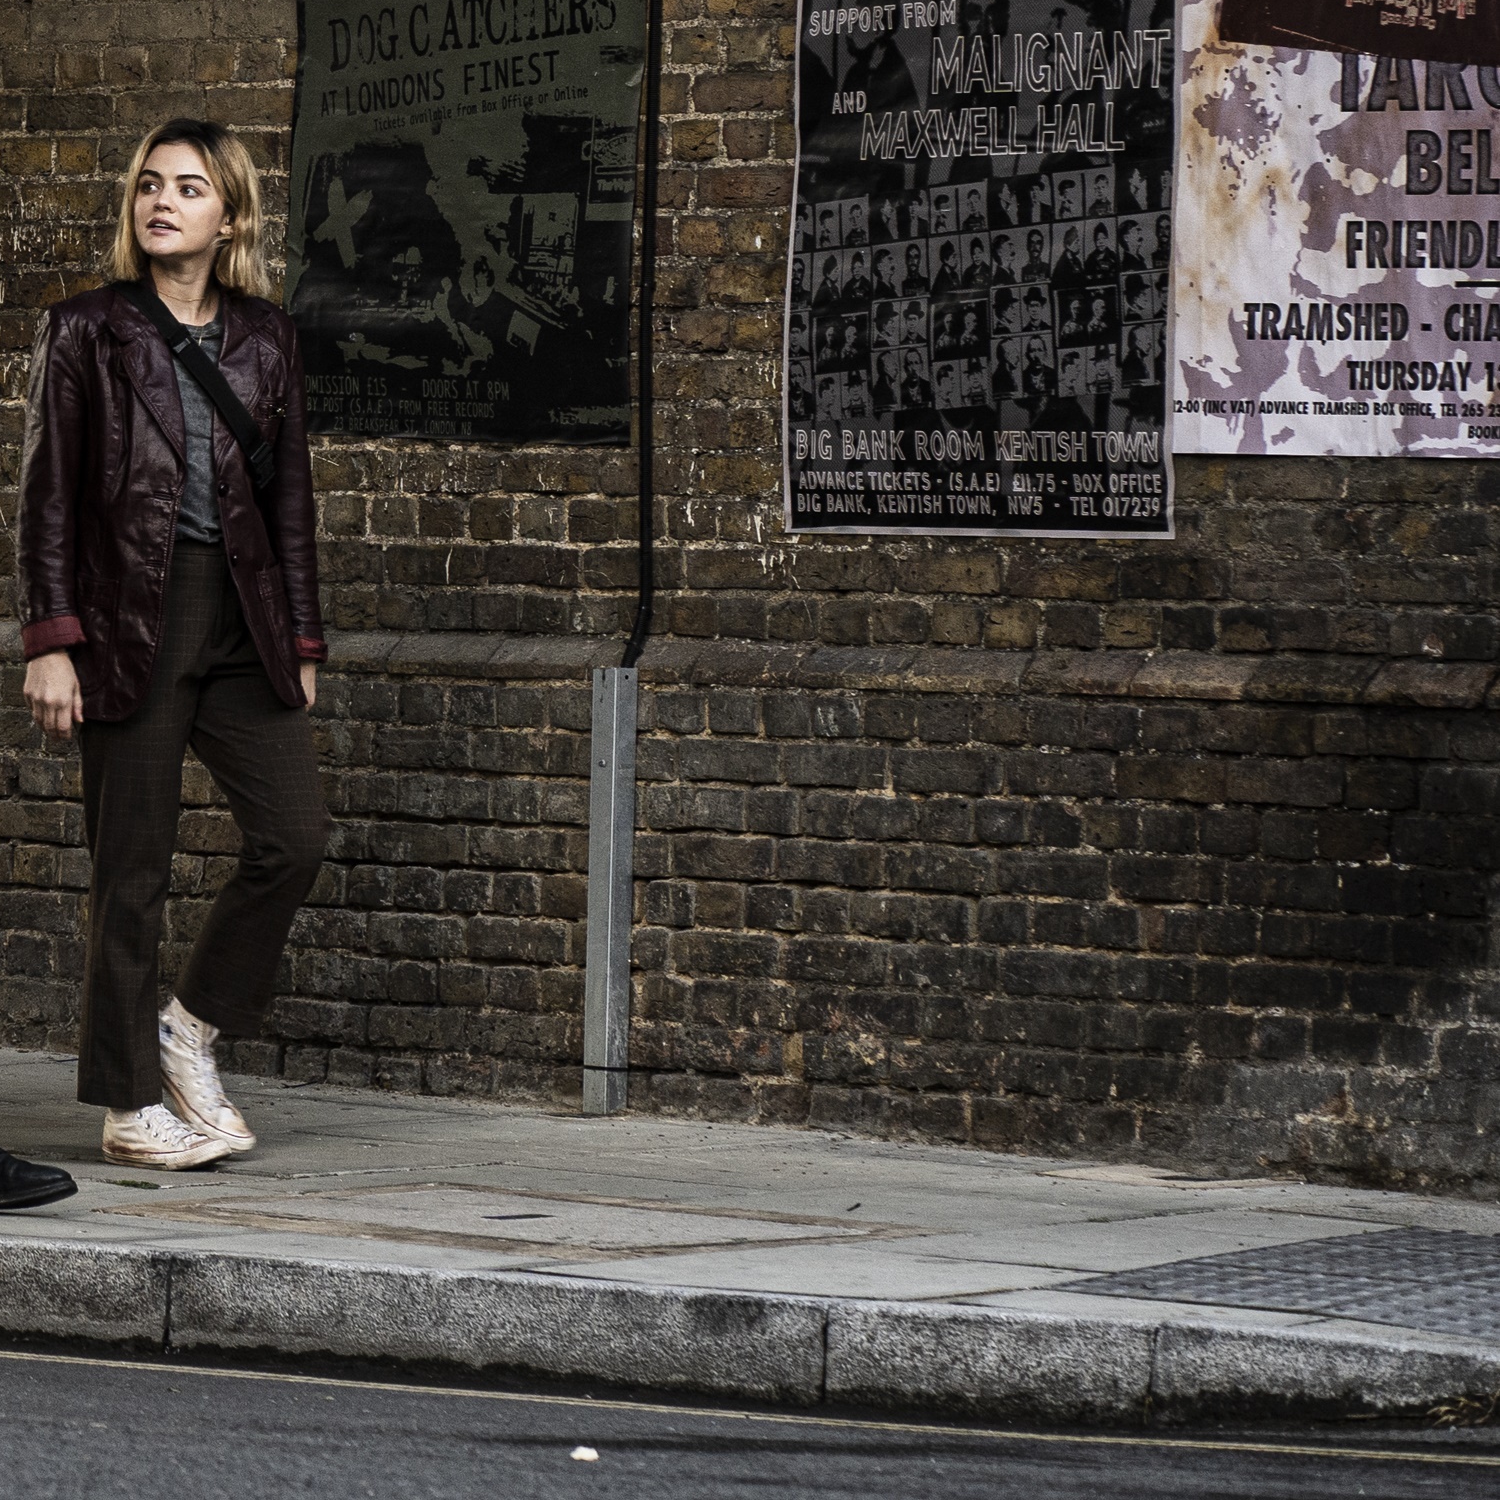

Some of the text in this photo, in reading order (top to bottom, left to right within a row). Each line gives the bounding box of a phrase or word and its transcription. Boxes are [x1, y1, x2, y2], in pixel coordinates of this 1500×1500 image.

[808, 0, 958, 37] SUPPORT FROM
[328, 8, 401, 73] DOG
[931, 28, 1172, 95] MALIGNANT
[320, 50, 561, 117] AT LONDONS FINEST
[373, 85, 590, 133] Tickets available from Box Office or Online
[831, 89, 868, 115] AND
[860, 101, 1126, 161] MAXWELL HALL
[1405, 128, 1500, 195] BEL
[1346, 220, 1500, 269] FRIENDL
[1244, 302, 1410, 341] TRAMSHED
[304, 374, 361, 396] DMISSION
[366, 376, 389, 398] £15
[421, 378, 460, 399] DOORS
[465, 380, 482, 400] AT
[486, 380, 511, 402] 8PM
[1346, 360, 1500, 391] THURSDAY 1
[306, 396, 319, 412] BY
[322, 397, 345, 413] POST
[398, 400, 424, 417] FROM
[427, 400, 451, 418] FREE
[454, 401, 496, 419] RECORDS
[1203, 400, 1227, 416] (INC
[1230, 400, 1256, 417] VAT)
[1258, 401, 1309, 415] ADVANCE
[1312, 401, 1369, 416] TRAMSHED
[1373, 401, 1396, 416] BOX
[1398, 402, 1436, 419] OFFICE,
[1440, 403, 1459, 417] TEL
[1461, 403, 1485, 417] 265
[333, 416, 345, 431] 23
[348, 417, 401, 433] BREAKSPEAR
[424, 419, 458, 436] LONDON
[795, 429, 1160, 463] BIG BANK ROOM KENTISH TOWN
[799, 471, 866, 492] ADVANCE
[867, 471, 932, 492] TICKETS
[1072, 473, 1105, 494] BOX
[1109, 474, 1163, 495] OFFICE
[797, 493, 822, 514] BIG
[826, 494, 872, 515] BANK,
[877, 494, 943, 514] KENTISH
[945, 495, 997, 516] TOWN,
[1007, 496, 1044, 516] NW5
[1069, 497, 1099, 516] TEL
[1102, 497, 1162, 518] 017239
